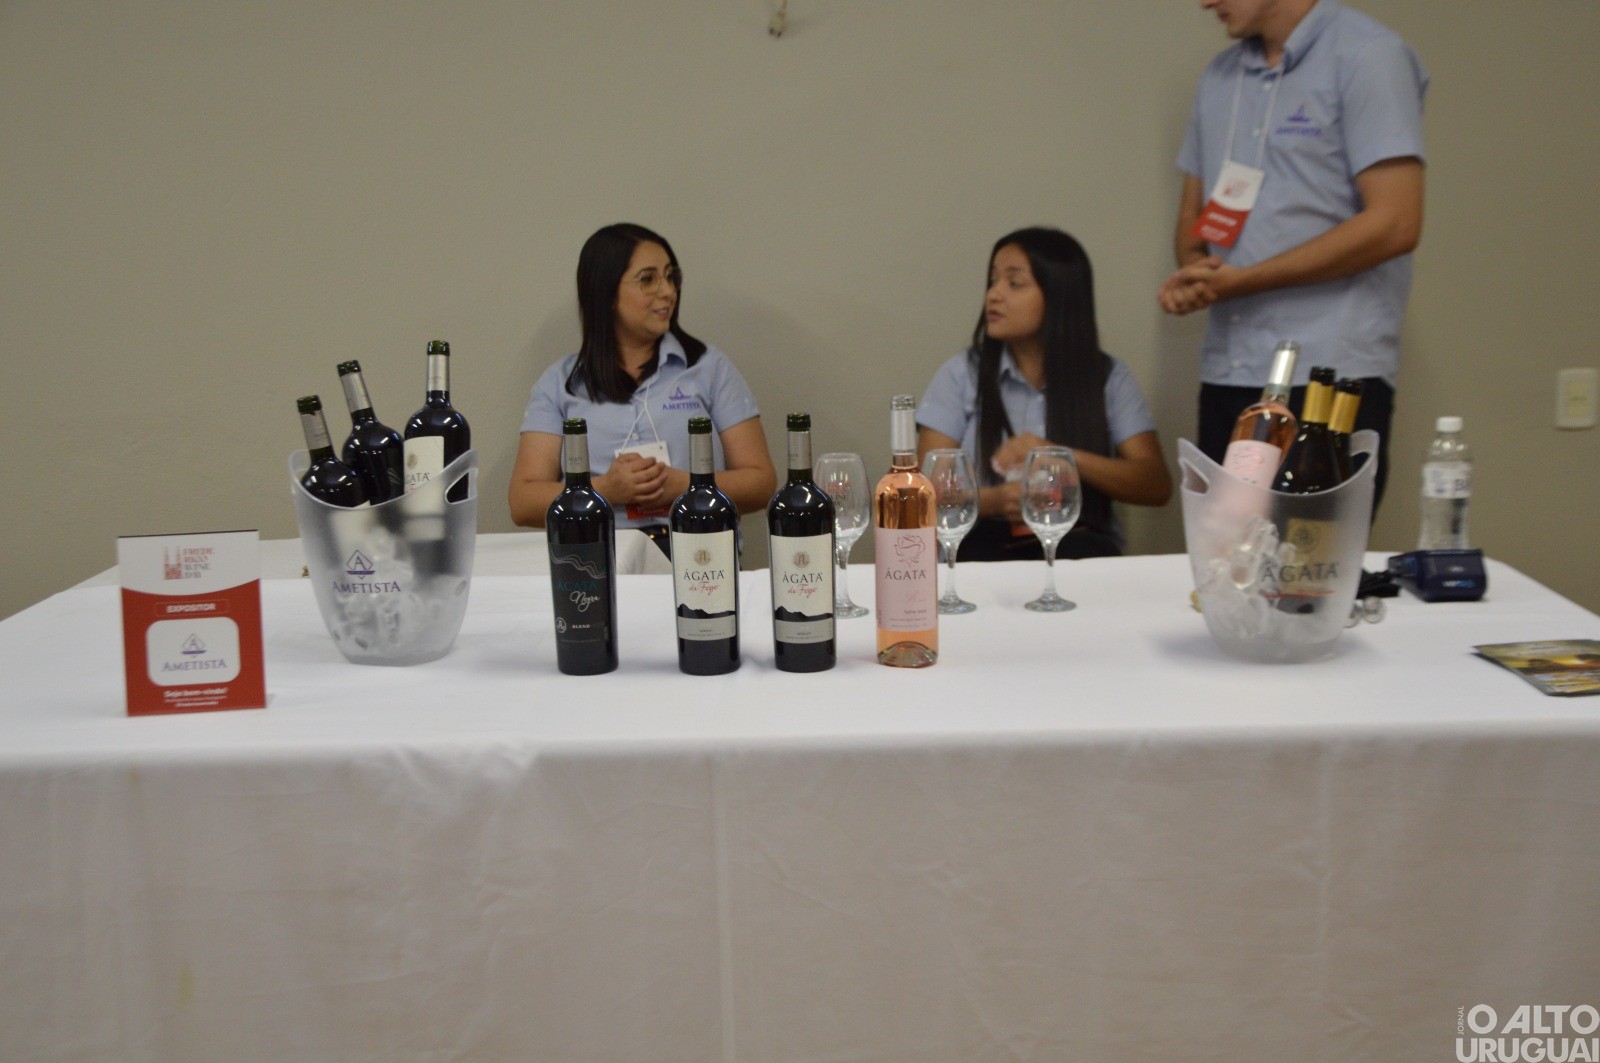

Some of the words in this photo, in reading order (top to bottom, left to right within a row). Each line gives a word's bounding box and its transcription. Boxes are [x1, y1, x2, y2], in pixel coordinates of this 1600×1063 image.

[683, 568, 725, 581] ÁGATA
[782, 571, 823, 584] ÁGATA
[885, 567, 926, 581] ÁGATA
[332, 580, 402, 593] AMETISTA
[166, 603, 216, 613] EXPOSITOR
[570, 590, 601, 613] Negra
[162, 658, 227, 671] AMETISTA
